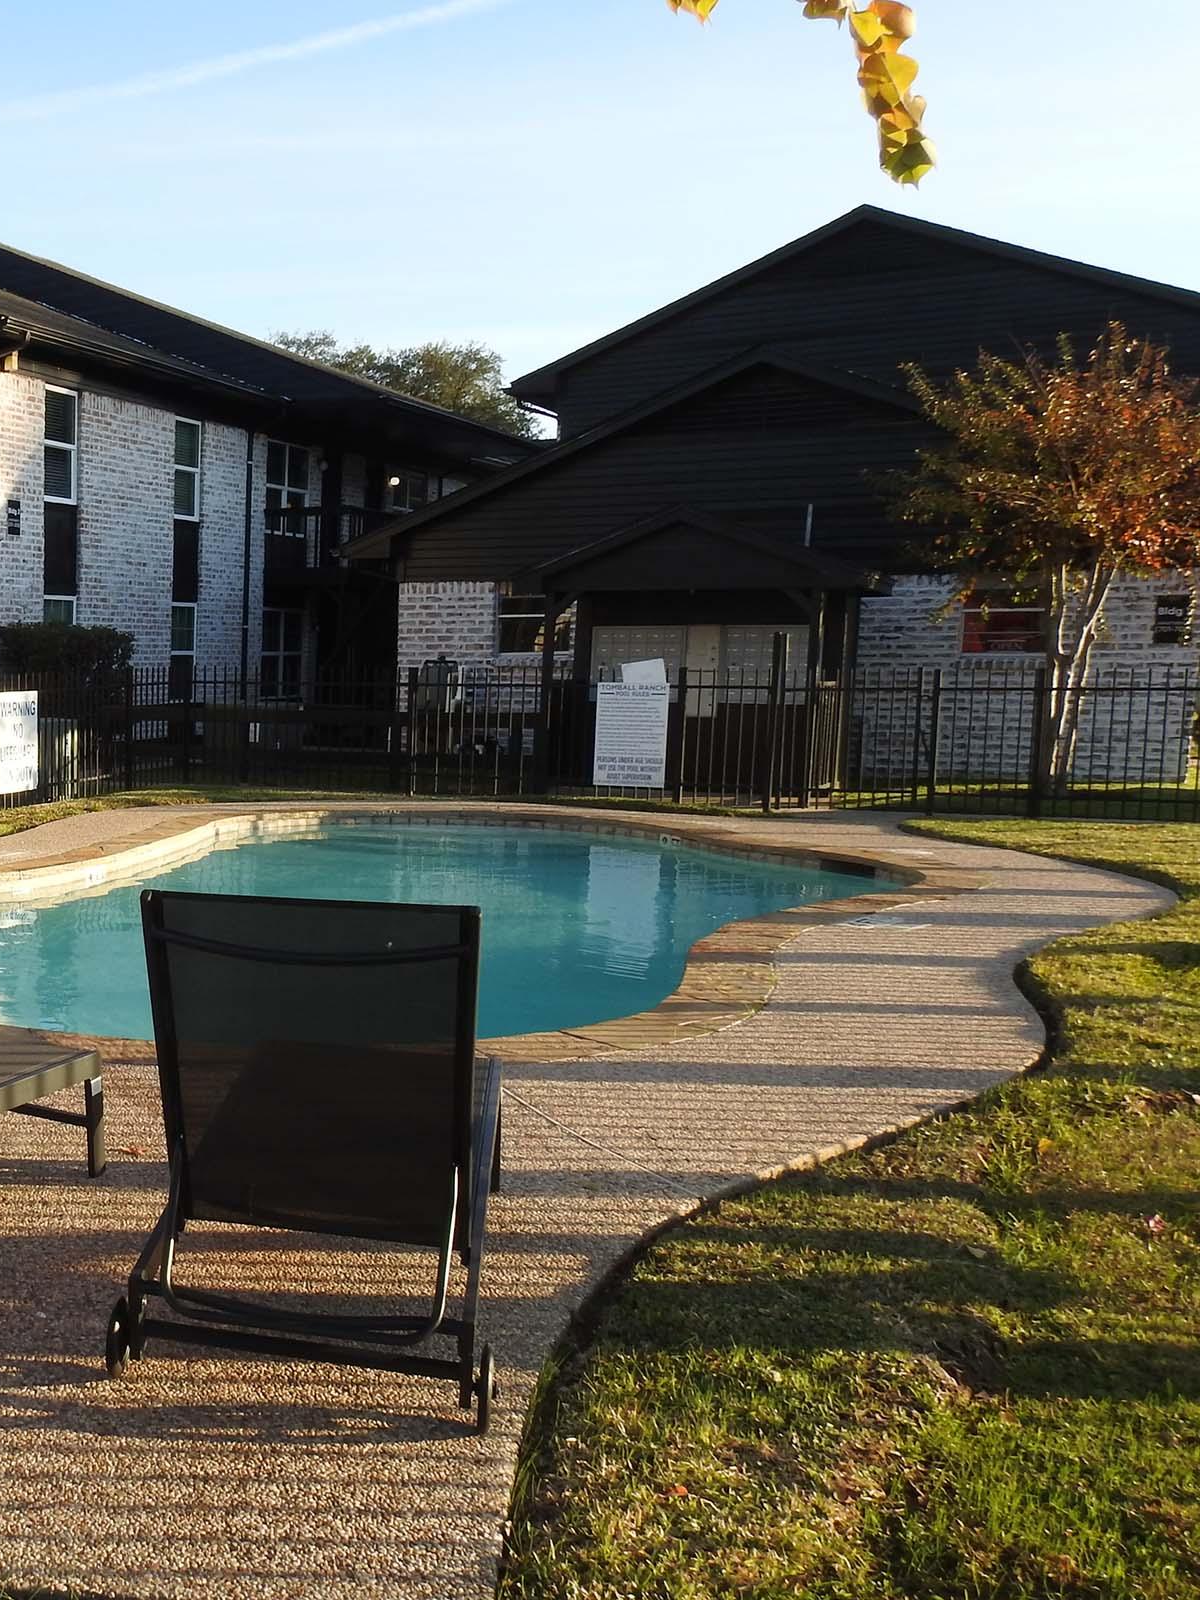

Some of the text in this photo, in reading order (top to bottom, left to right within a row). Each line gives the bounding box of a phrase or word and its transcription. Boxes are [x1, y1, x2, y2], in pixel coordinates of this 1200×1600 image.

[1157, 607, 1183, 617] Bldg
[0, 700, 36, 717] WARNING
[12, 723, 23, 738] NO
